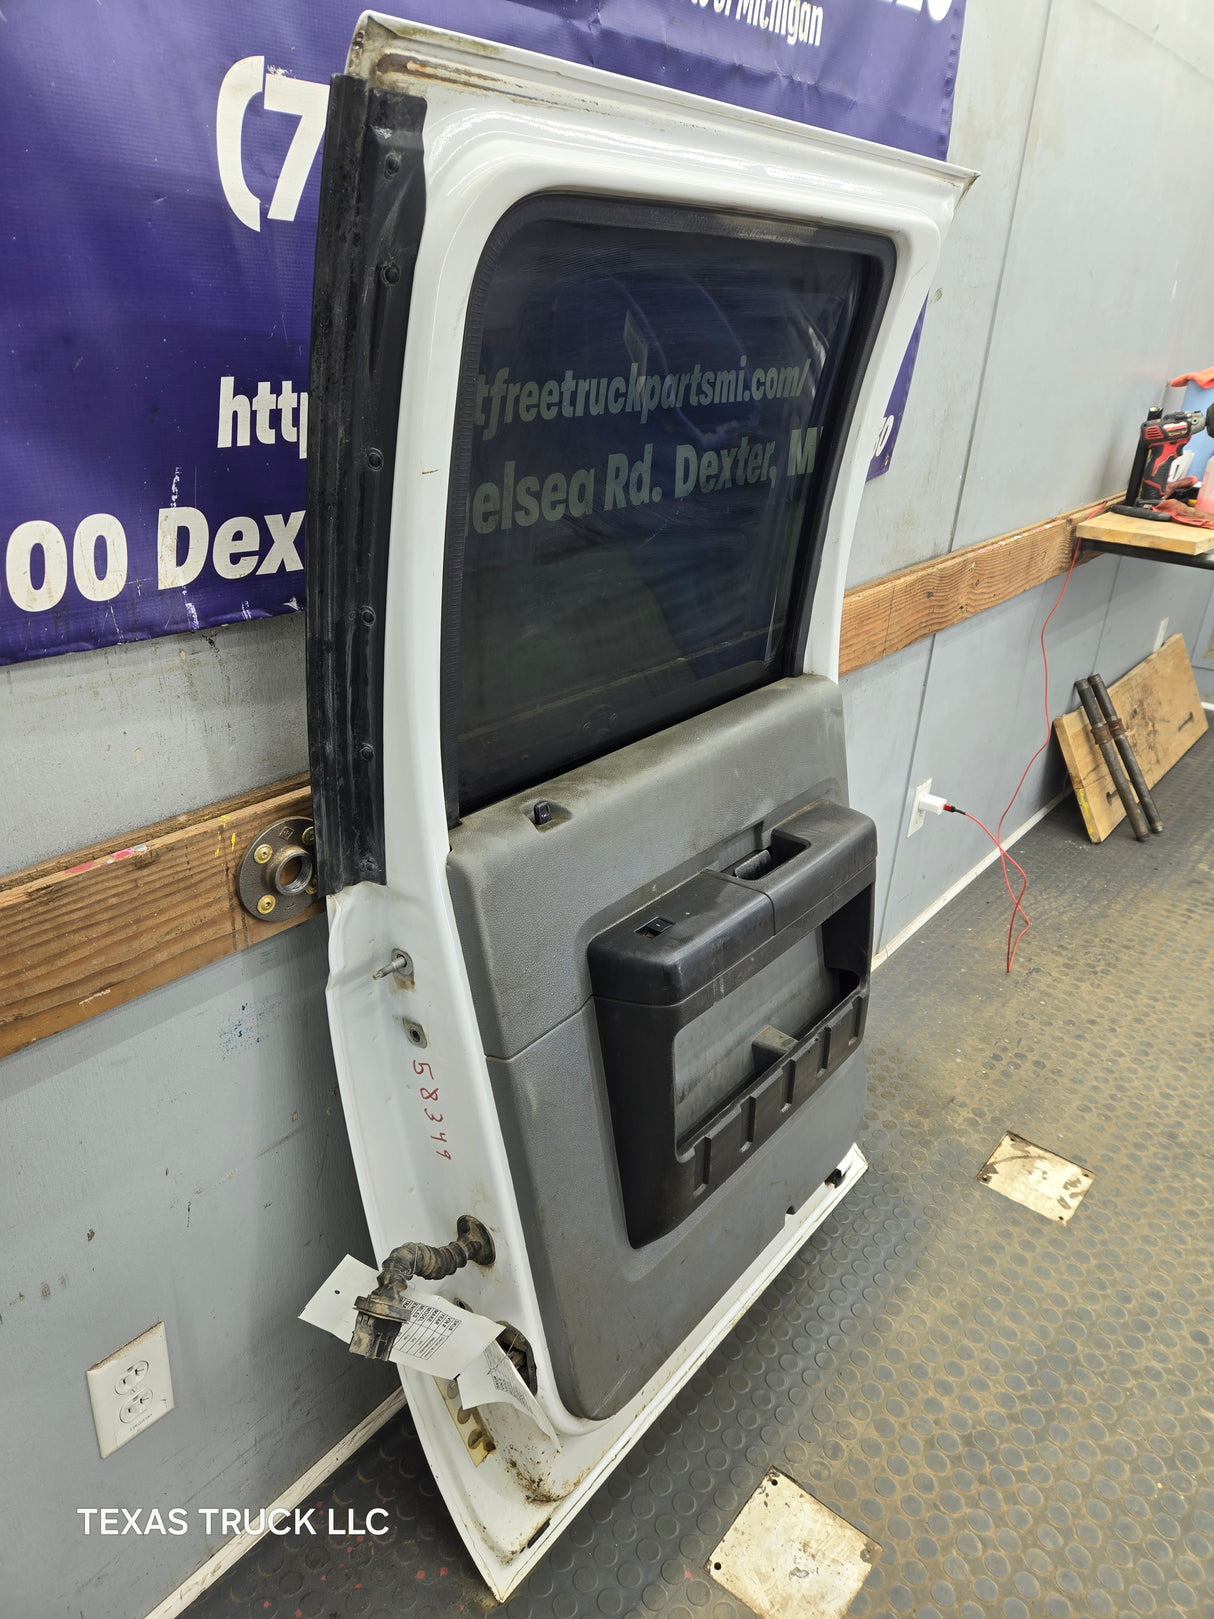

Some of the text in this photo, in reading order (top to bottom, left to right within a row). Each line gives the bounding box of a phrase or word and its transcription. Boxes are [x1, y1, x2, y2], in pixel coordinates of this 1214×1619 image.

[5, 513, 129, 612] 00
[157, 506, 306, 591] Dex
[466, 461, 595, 535] elsea
[604, 443, 663, 511] Rd.
[674, 436, 777, 499] Dexter,
[787, 426, 824, 477] M
